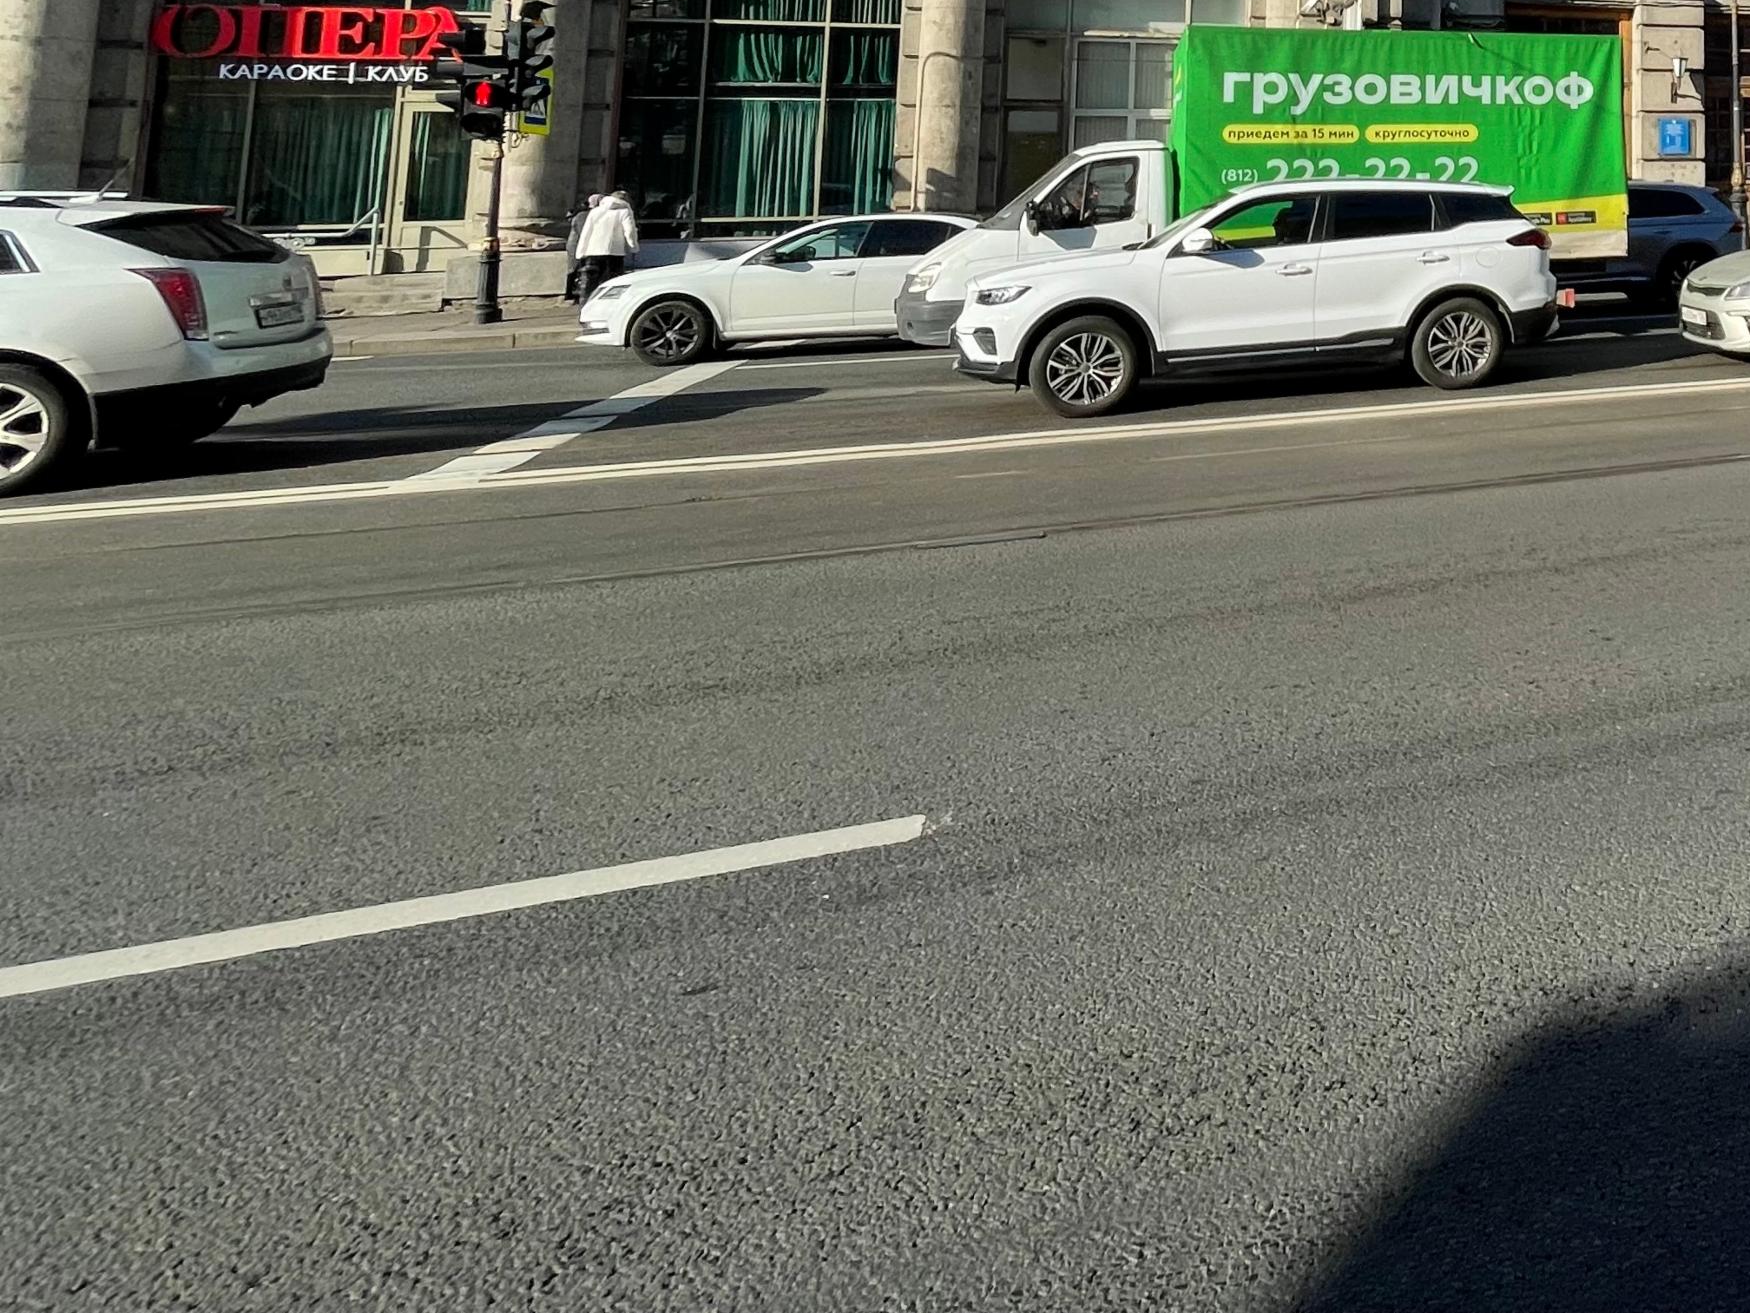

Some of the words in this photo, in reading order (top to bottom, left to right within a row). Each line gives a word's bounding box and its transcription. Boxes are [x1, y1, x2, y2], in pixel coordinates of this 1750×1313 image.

[151, 4, 461, 62] ОПЕРА
[218, 63, 337, 81] КАРАОКЕ
[367, 65, 429, 83] КЛУБ
[1222, 71, 1595, 116] грузовичкоф
[1227, 128, 1290, 140] приедем
[1293, 129, 1309, 139] за
[1311, 127, 1325, 139] 15
[1328, 129, 1355, 139] мин
[1374, 127, 1470, 141] круглосуточно
[1221, 168, 1259, 185] (812)
